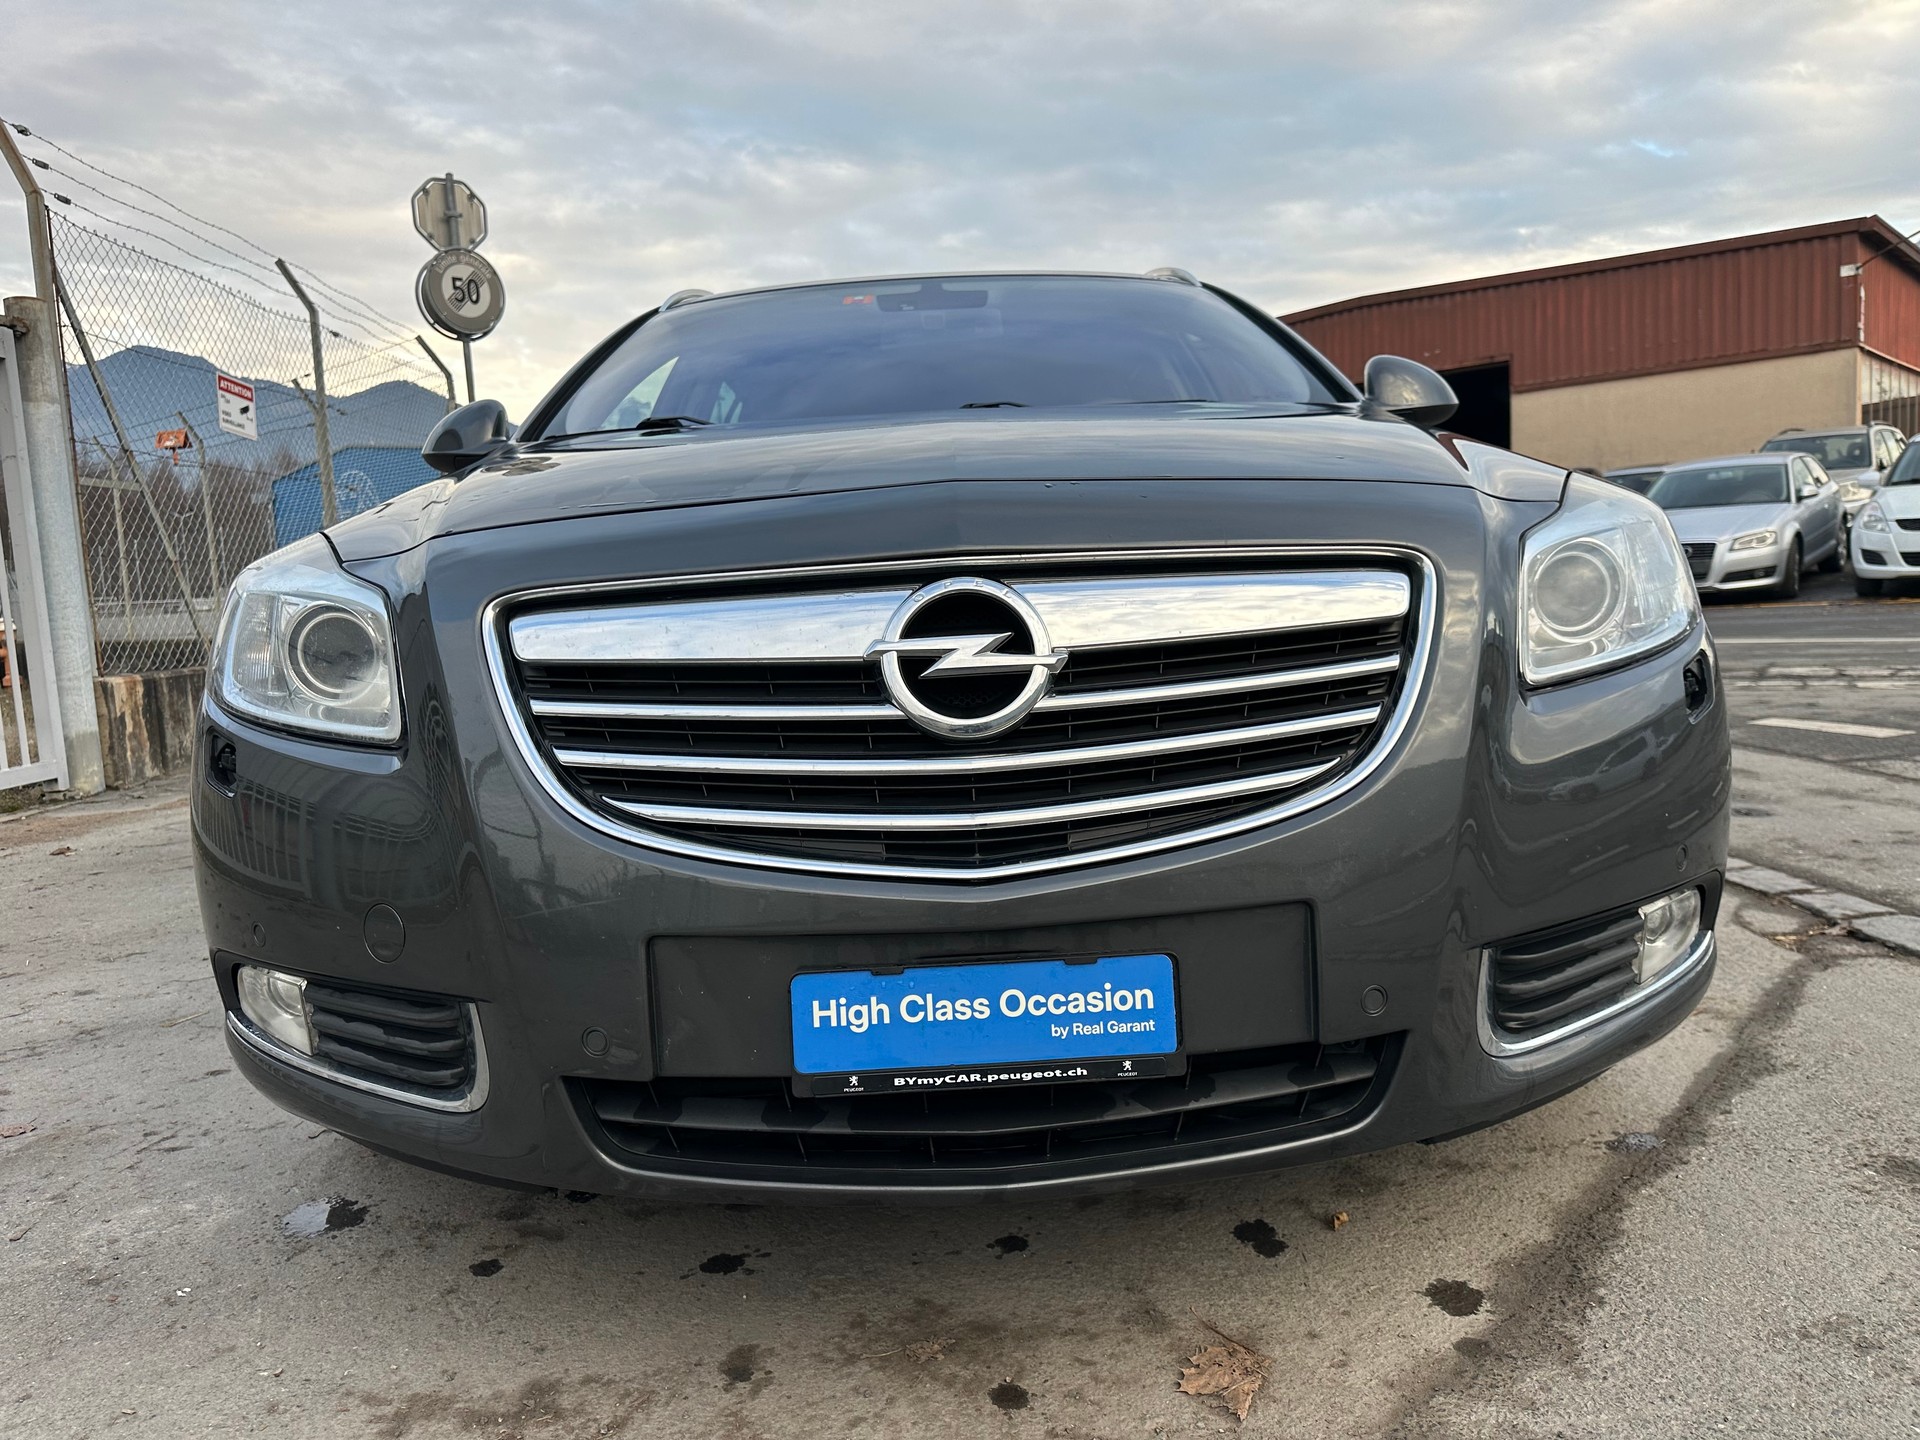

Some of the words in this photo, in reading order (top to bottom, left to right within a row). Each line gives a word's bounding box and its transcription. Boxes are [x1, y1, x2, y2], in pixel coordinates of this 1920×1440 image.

[451, 276, 481, 305] 50
[220, 379, 252, 399] ATTENTION
[913, 578, 1013, 602] OPEL
[812, 996, 891, 1033] High
[900, 993, 991, 1023] Class
[999, 982, 1155, 1018] Occasion
[1051, 1024, 1069, 1039] by
[1073, 1021, 1104, 1036] Real
[1107, 1019, 1156, 1034] Garant
[893, 1067, 1089, 1087] BYmyCAR.peugeot.ch
